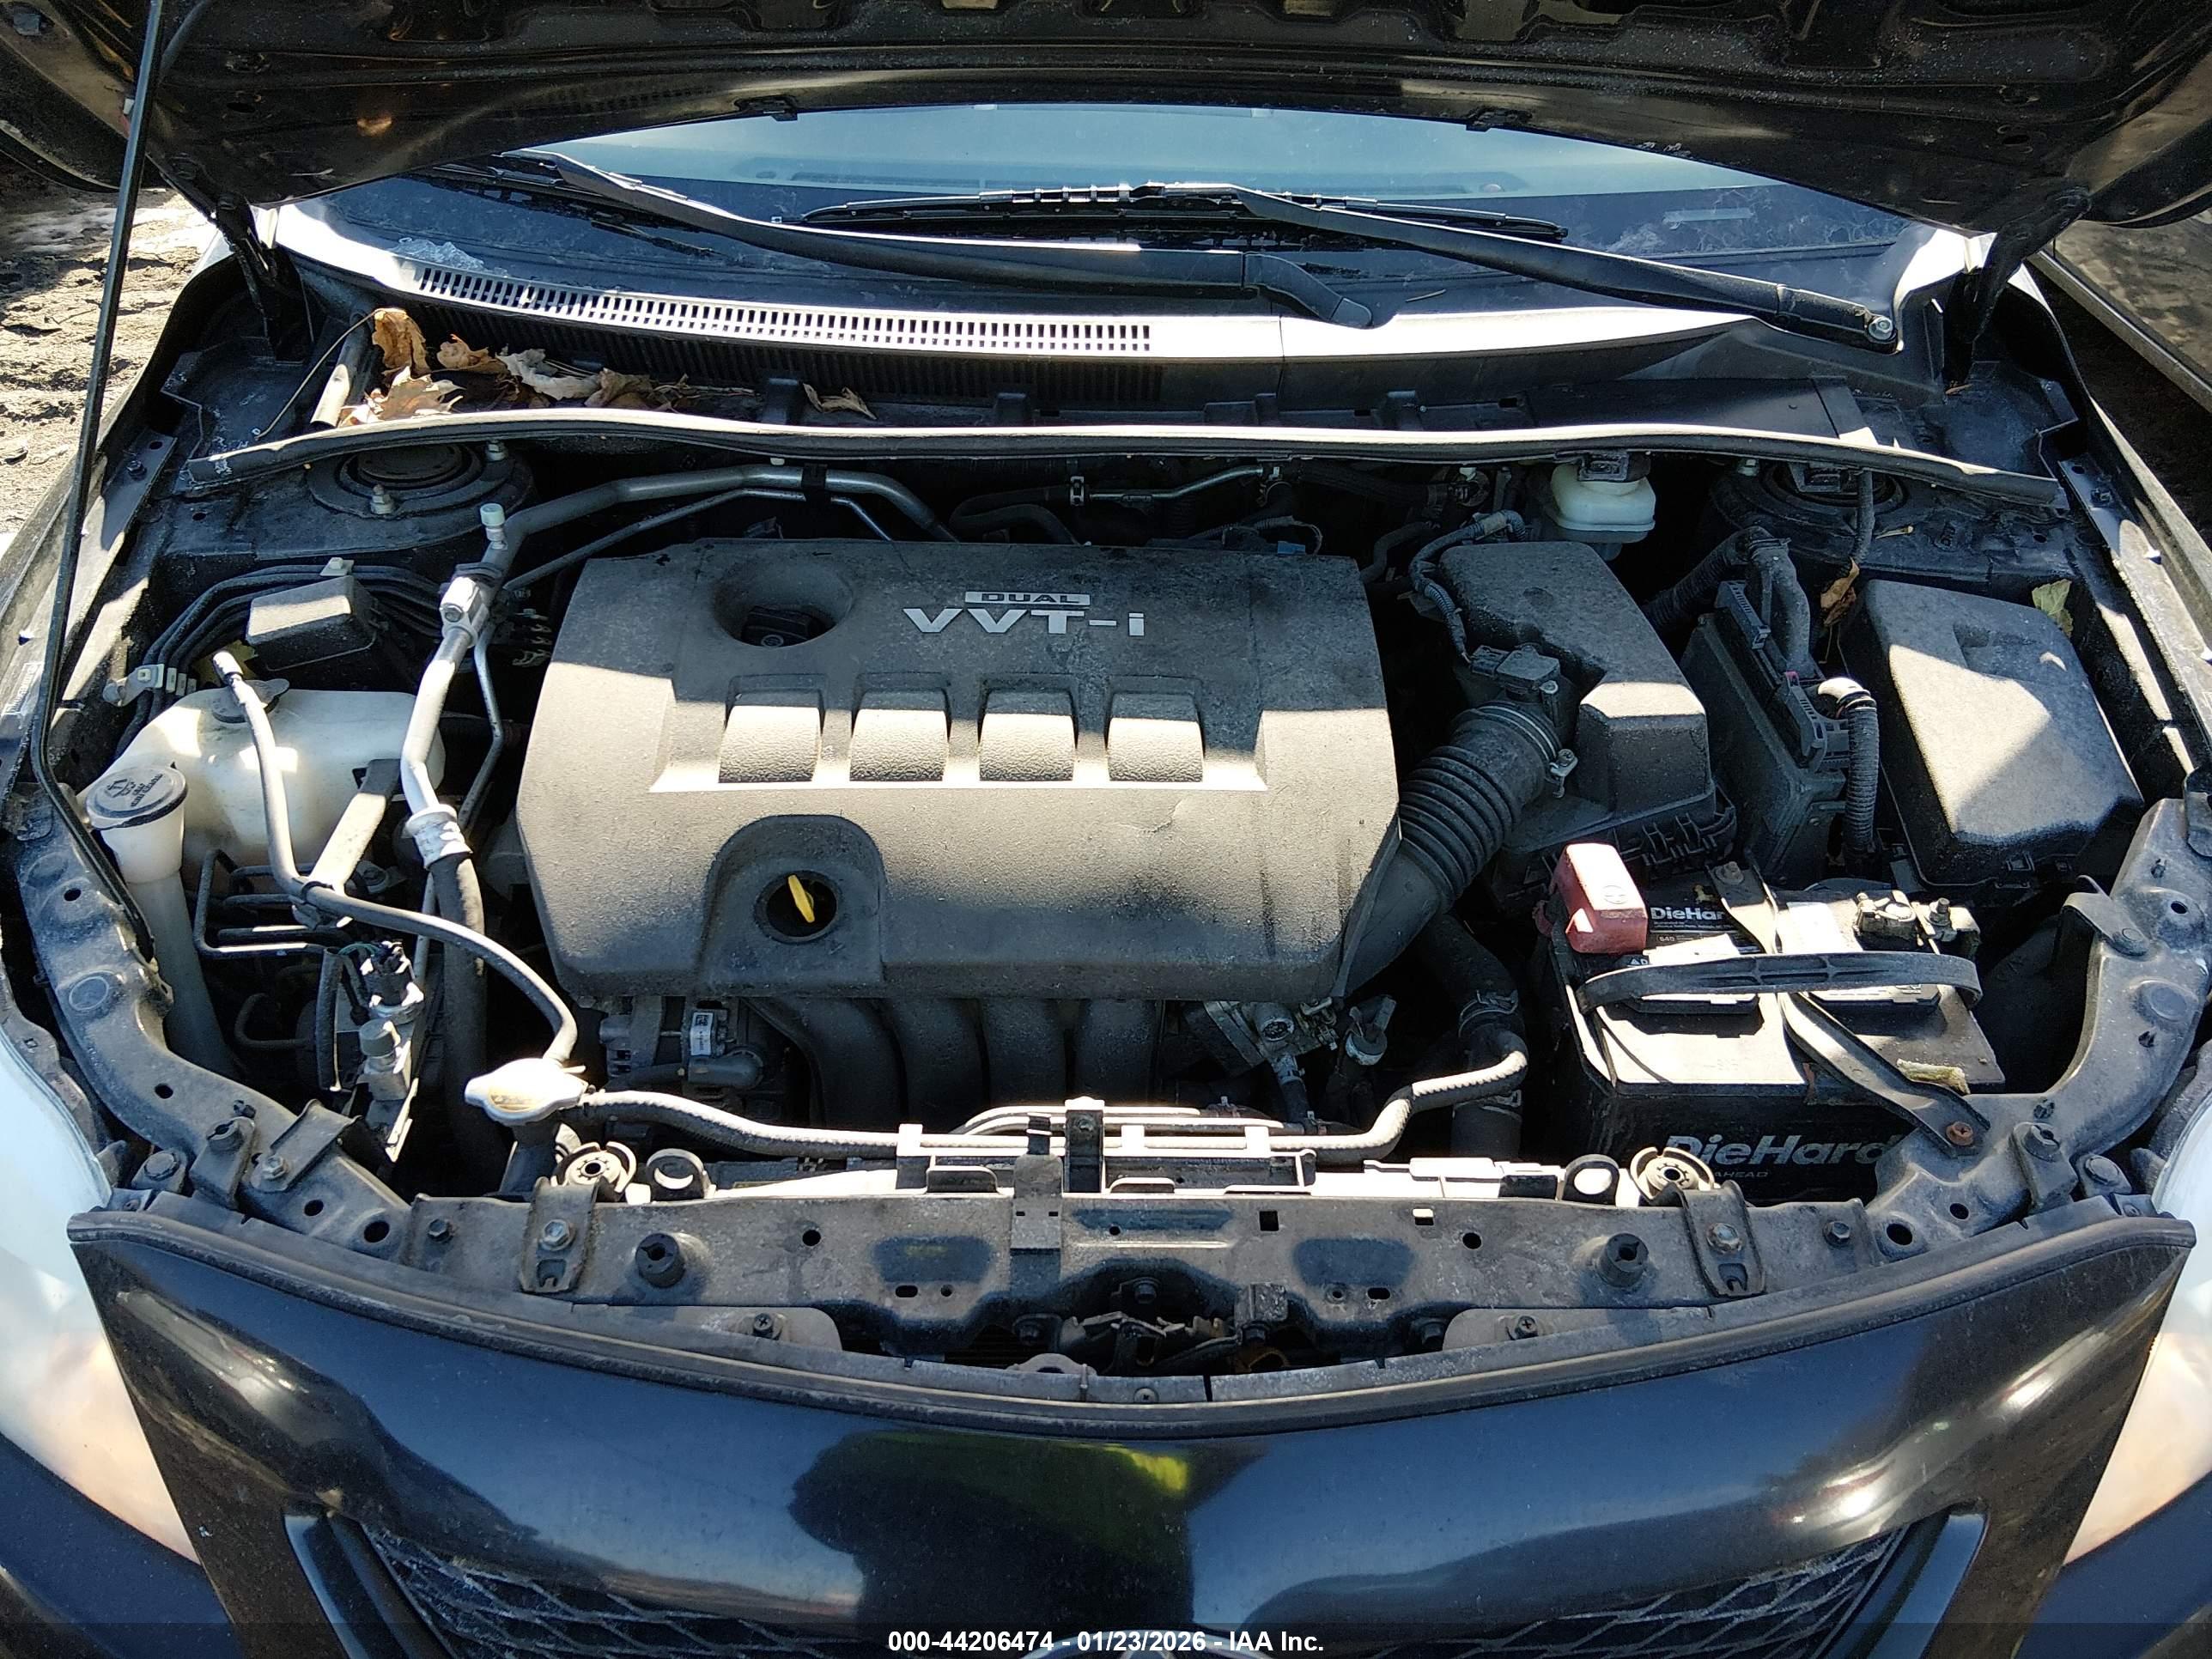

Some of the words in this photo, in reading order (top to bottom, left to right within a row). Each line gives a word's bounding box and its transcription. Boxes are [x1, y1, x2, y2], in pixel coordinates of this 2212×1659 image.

[981, 592, 1079, 604] DUAL
[902, 607, 1145, 636] VVT-i
[1650, 907, 1725, 921] DieHar
